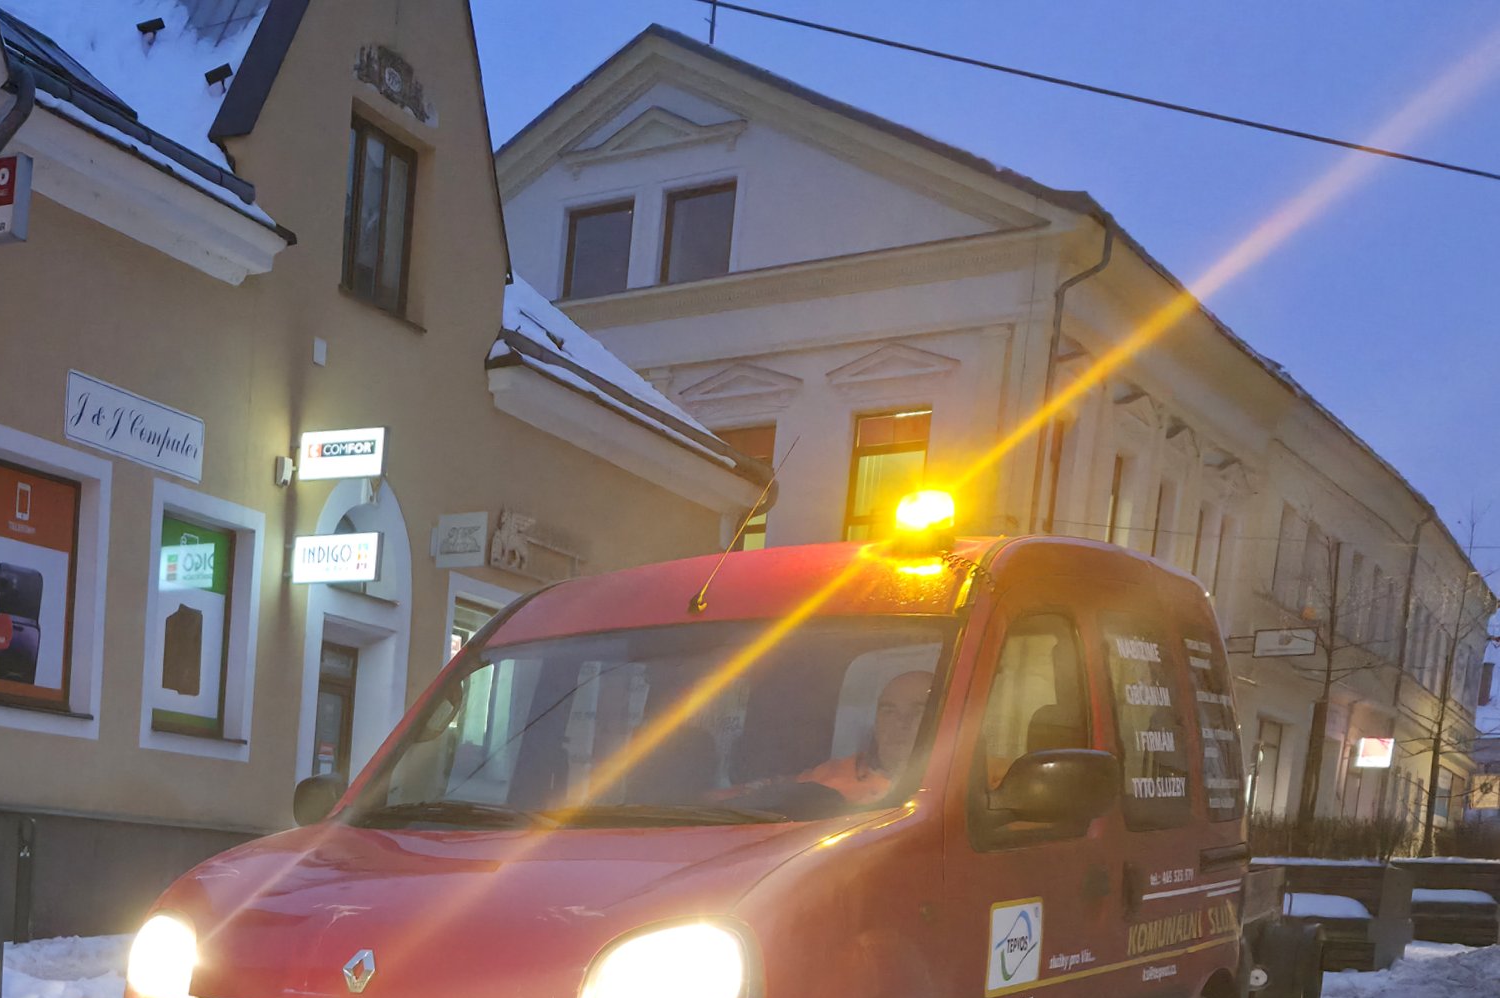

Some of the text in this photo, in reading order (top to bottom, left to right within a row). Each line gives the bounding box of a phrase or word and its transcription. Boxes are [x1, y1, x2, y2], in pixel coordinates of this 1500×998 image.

[70, 392, 198, 459] J & J Computer
[323, 441, 373, 455] COMFOR
[302, 544, 352, 564] INDIGO
[1132, 777, 1155, 798] TYTO
[1007, 936, 1028, 954] TEPVOS
